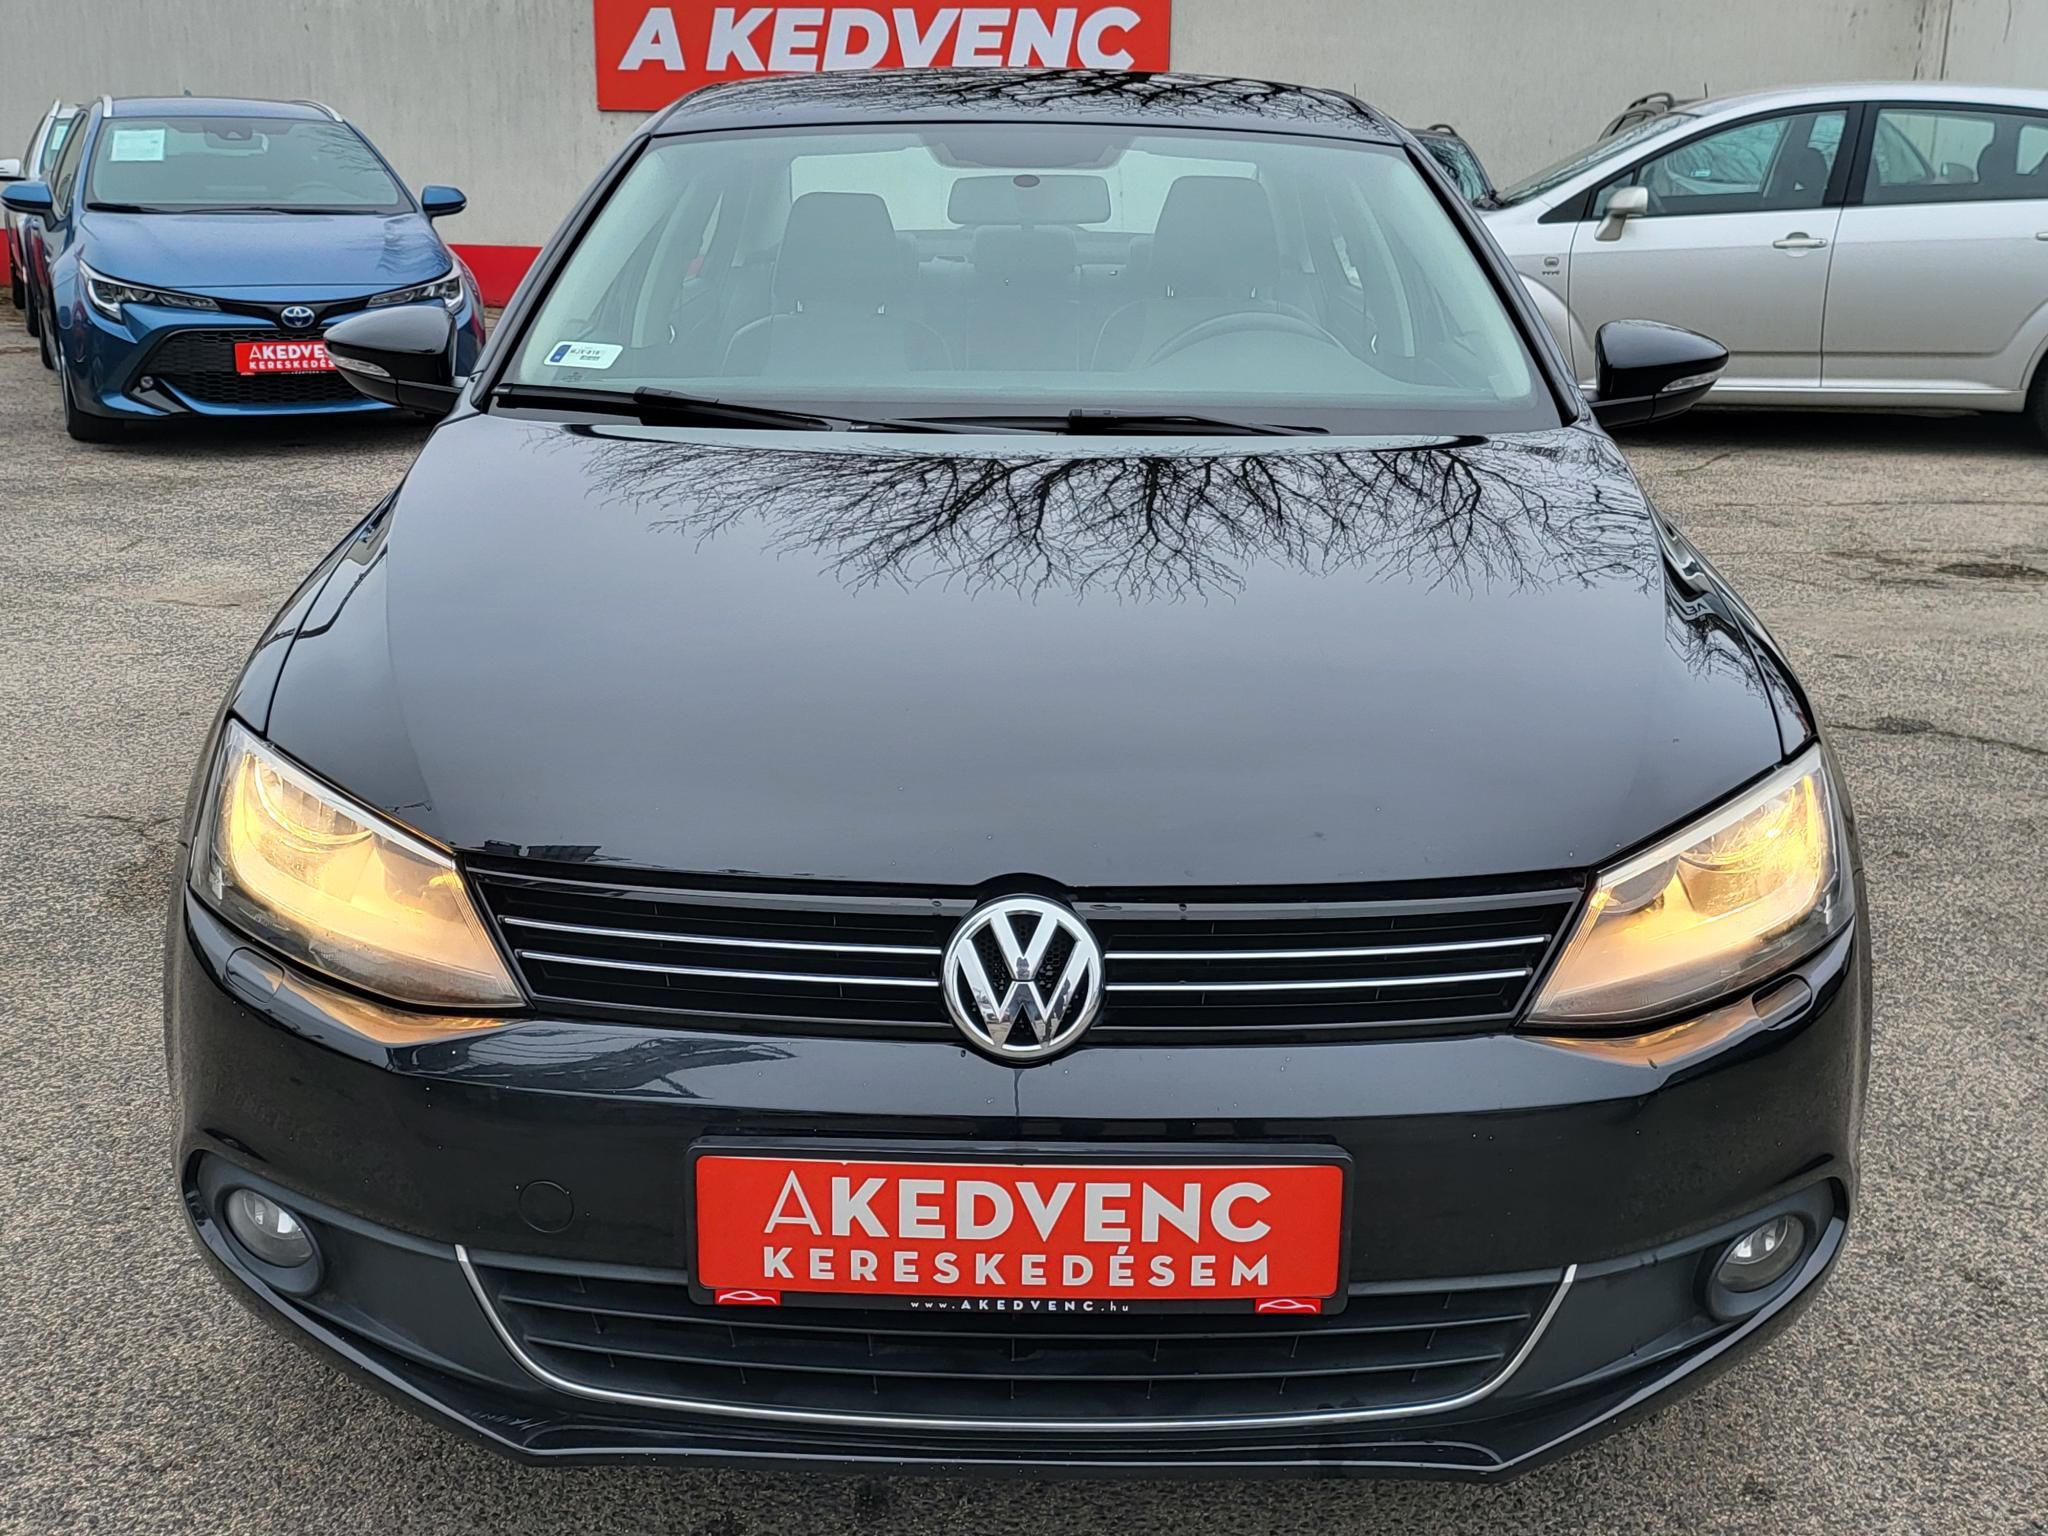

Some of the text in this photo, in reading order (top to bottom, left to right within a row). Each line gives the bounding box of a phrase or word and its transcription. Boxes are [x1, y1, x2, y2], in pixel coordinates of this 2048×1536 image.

[617, 7, 1141, 71] A KEDVENC
[763, 1246, 1270, 1287] KERESKEDÉSEM
[910, 1299, 1129, 1312] www.AKEDVENC.hu
